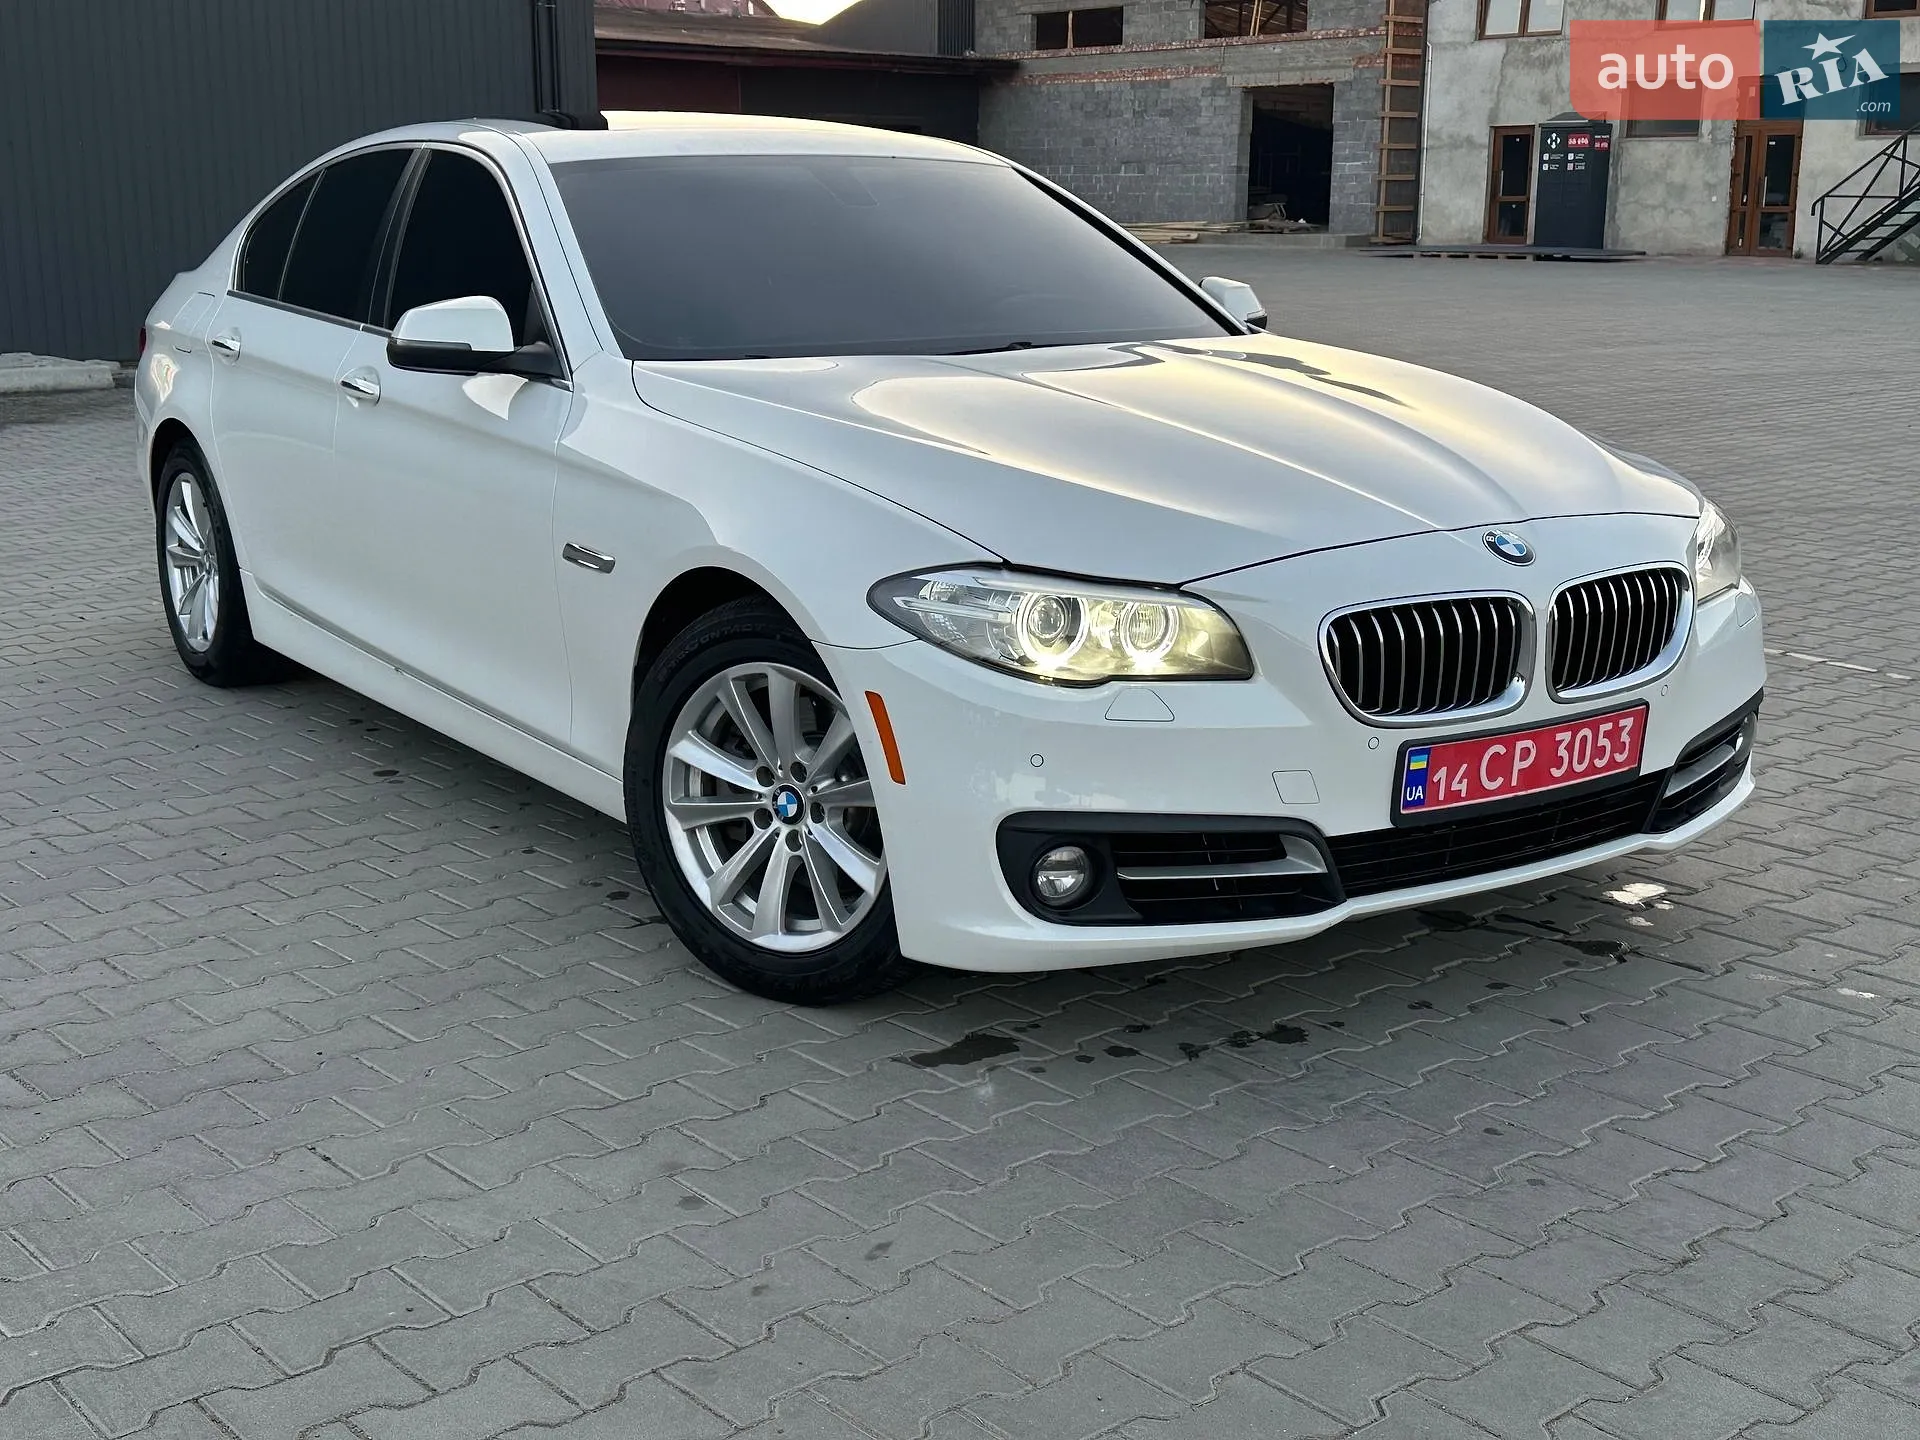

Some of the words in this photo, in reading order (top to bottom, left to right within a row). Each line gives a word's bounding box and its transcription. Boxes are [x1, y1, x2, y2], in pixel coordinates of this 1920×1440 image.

[1432, 763, 1469, 801] 14
[1479, 739, 1537, 792] CP
[1549, 716, 1634, 779] 3053
[1406, 785, 1424, 801] UA
